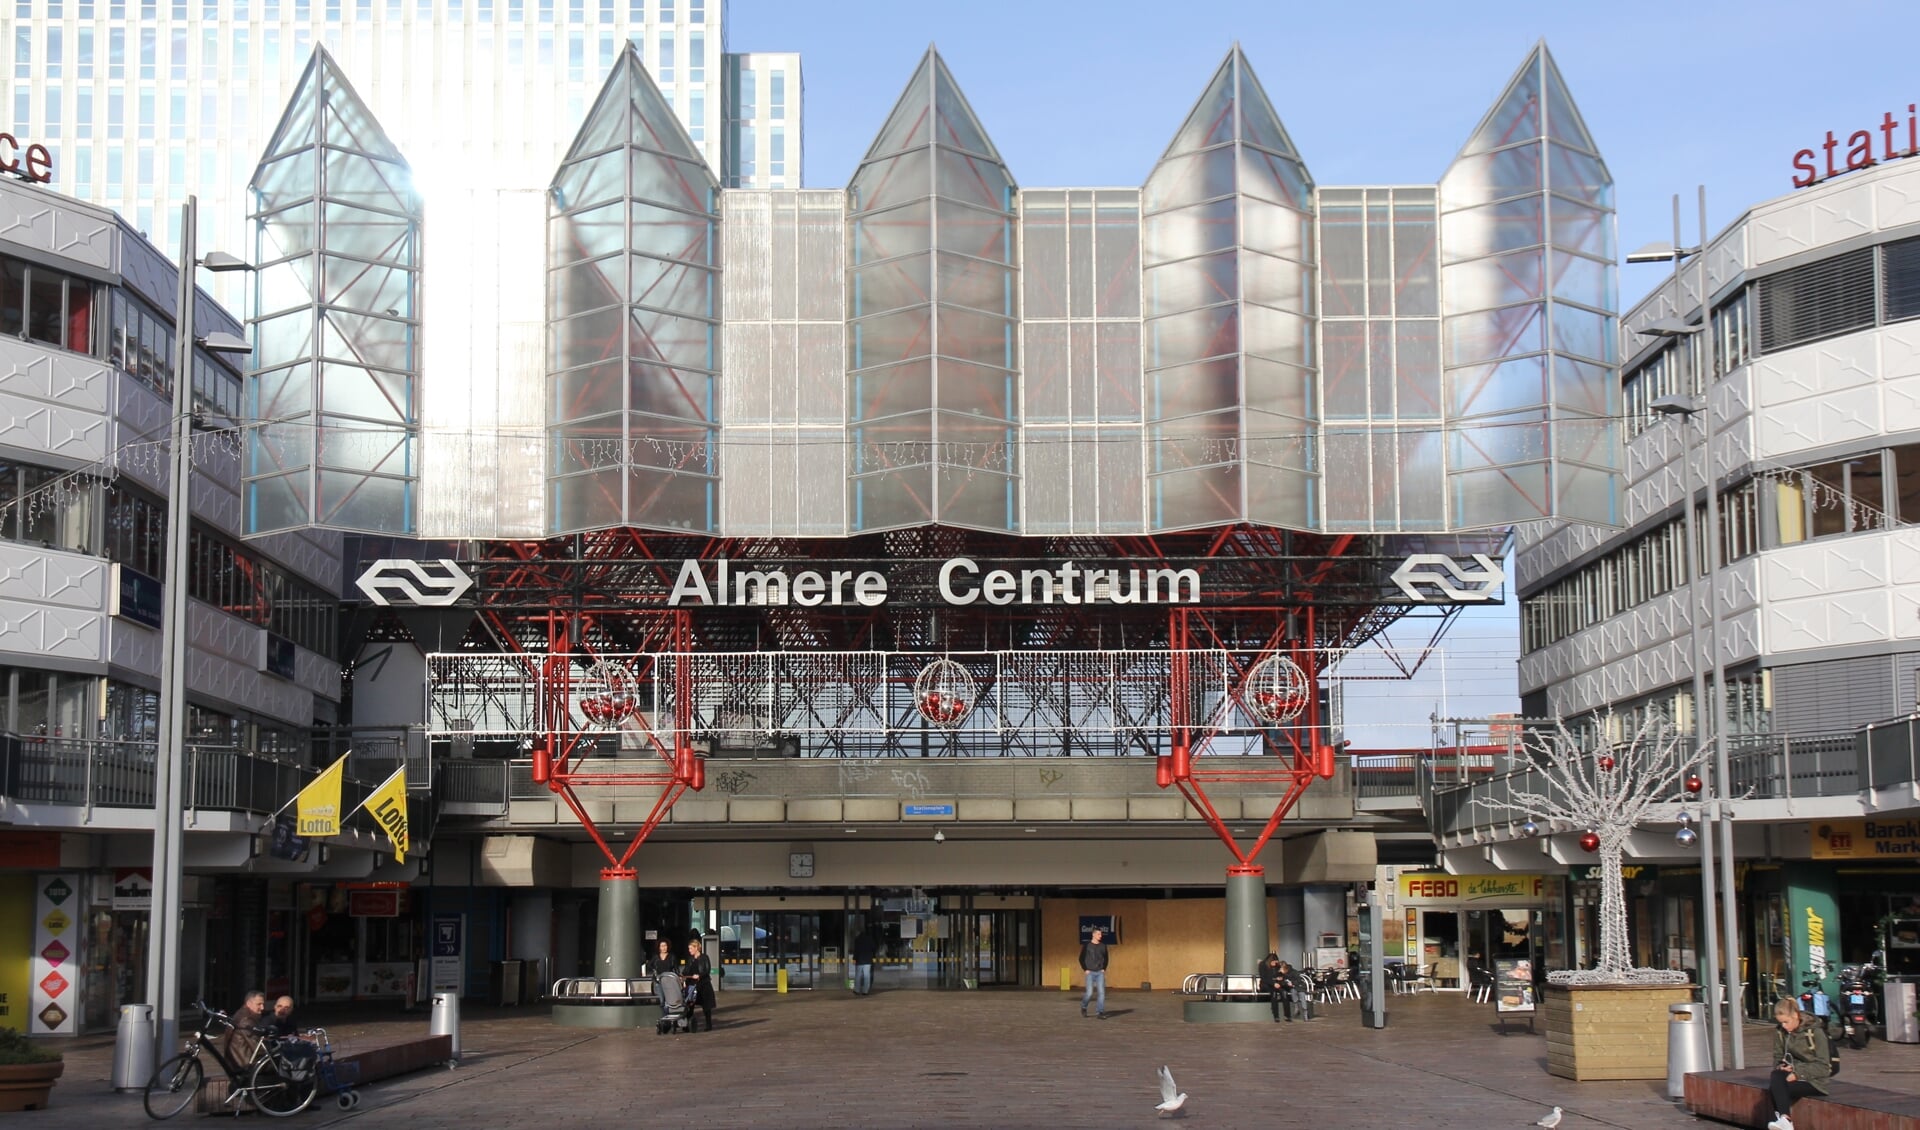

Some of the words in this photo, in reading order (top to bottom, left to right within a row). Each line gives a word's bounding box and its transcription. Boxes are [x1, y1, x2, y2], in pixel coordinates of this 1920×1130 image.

[1792, 103, 1917, 188] stati
[667, 558, 888, 607] Almere
[938, 557, 1200, 606] Centrum
[1408, 880, 1458, 897] FEBO
[1805, 906, 1827, 980] SUBWAY
